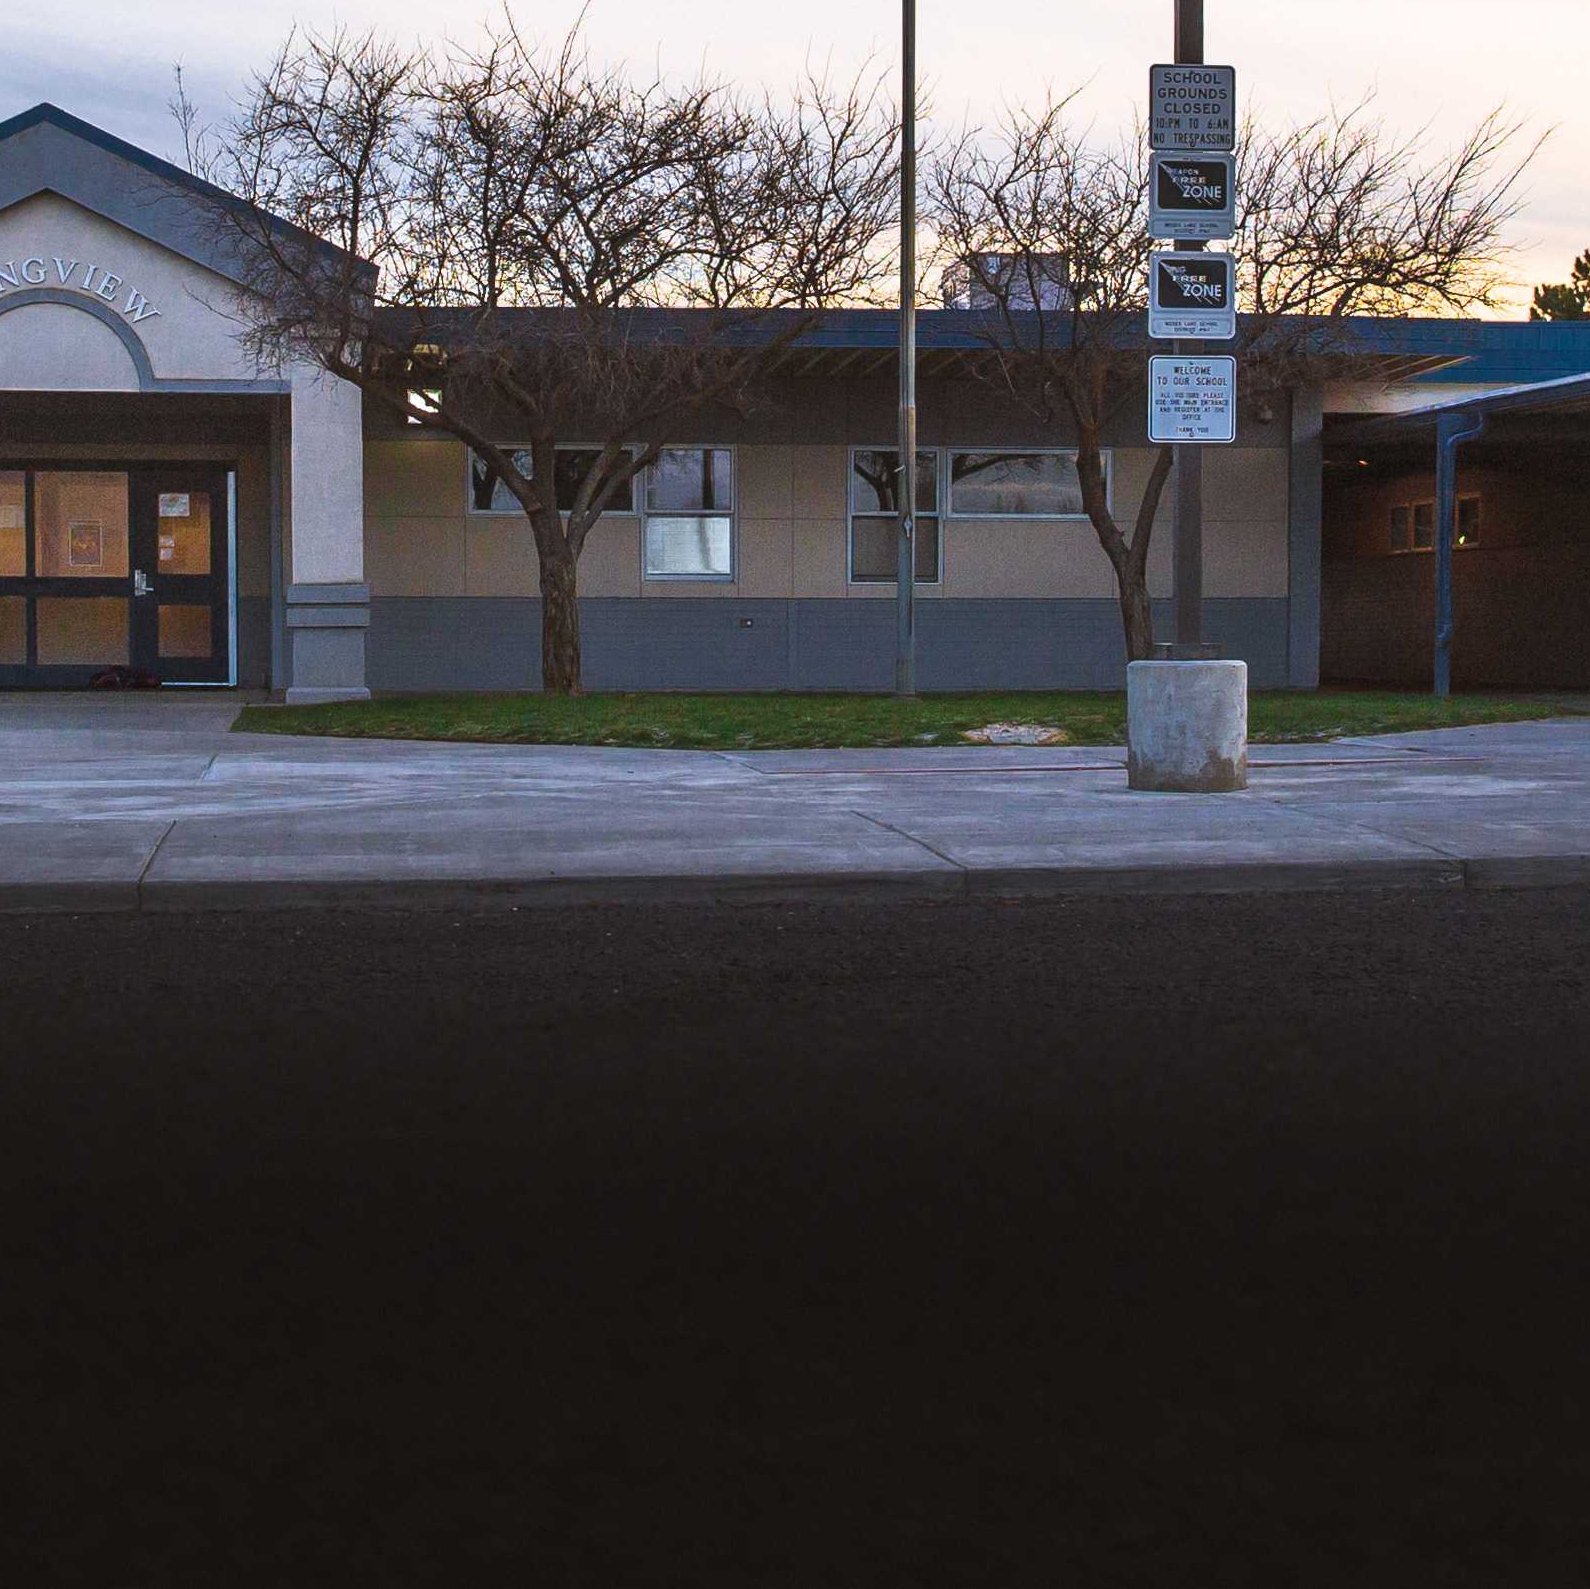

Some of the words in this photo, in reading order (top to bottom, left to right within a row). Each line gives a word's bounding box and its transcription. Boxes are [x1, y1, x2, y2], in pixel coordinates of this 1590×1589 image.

[1163, 72, 1222, 84] SCHOOL
[1157, 87, 1228, 99] GROUNDS
[1163, 102, 1221, 114] CLOSED
[1188, 117, 1199, 129] TO
[1153, 132, 1165, 144] NO
[1173, 132, 1231, 145] TRESPASSING
[1172, 176, 1207, 184] FREE
[1182, 185, 1222, 198] ZONE
[1172, 275, 1207, 283] FREE
[1182, 284, 1222, 297] ZONE
[1174, 366, 1212, 375] WELCOME
[1157, 376, 1168, 386] TO
[1173, 376, 1190, 386] OUR
[1195, 377, 1228, 386] SCHOOL
